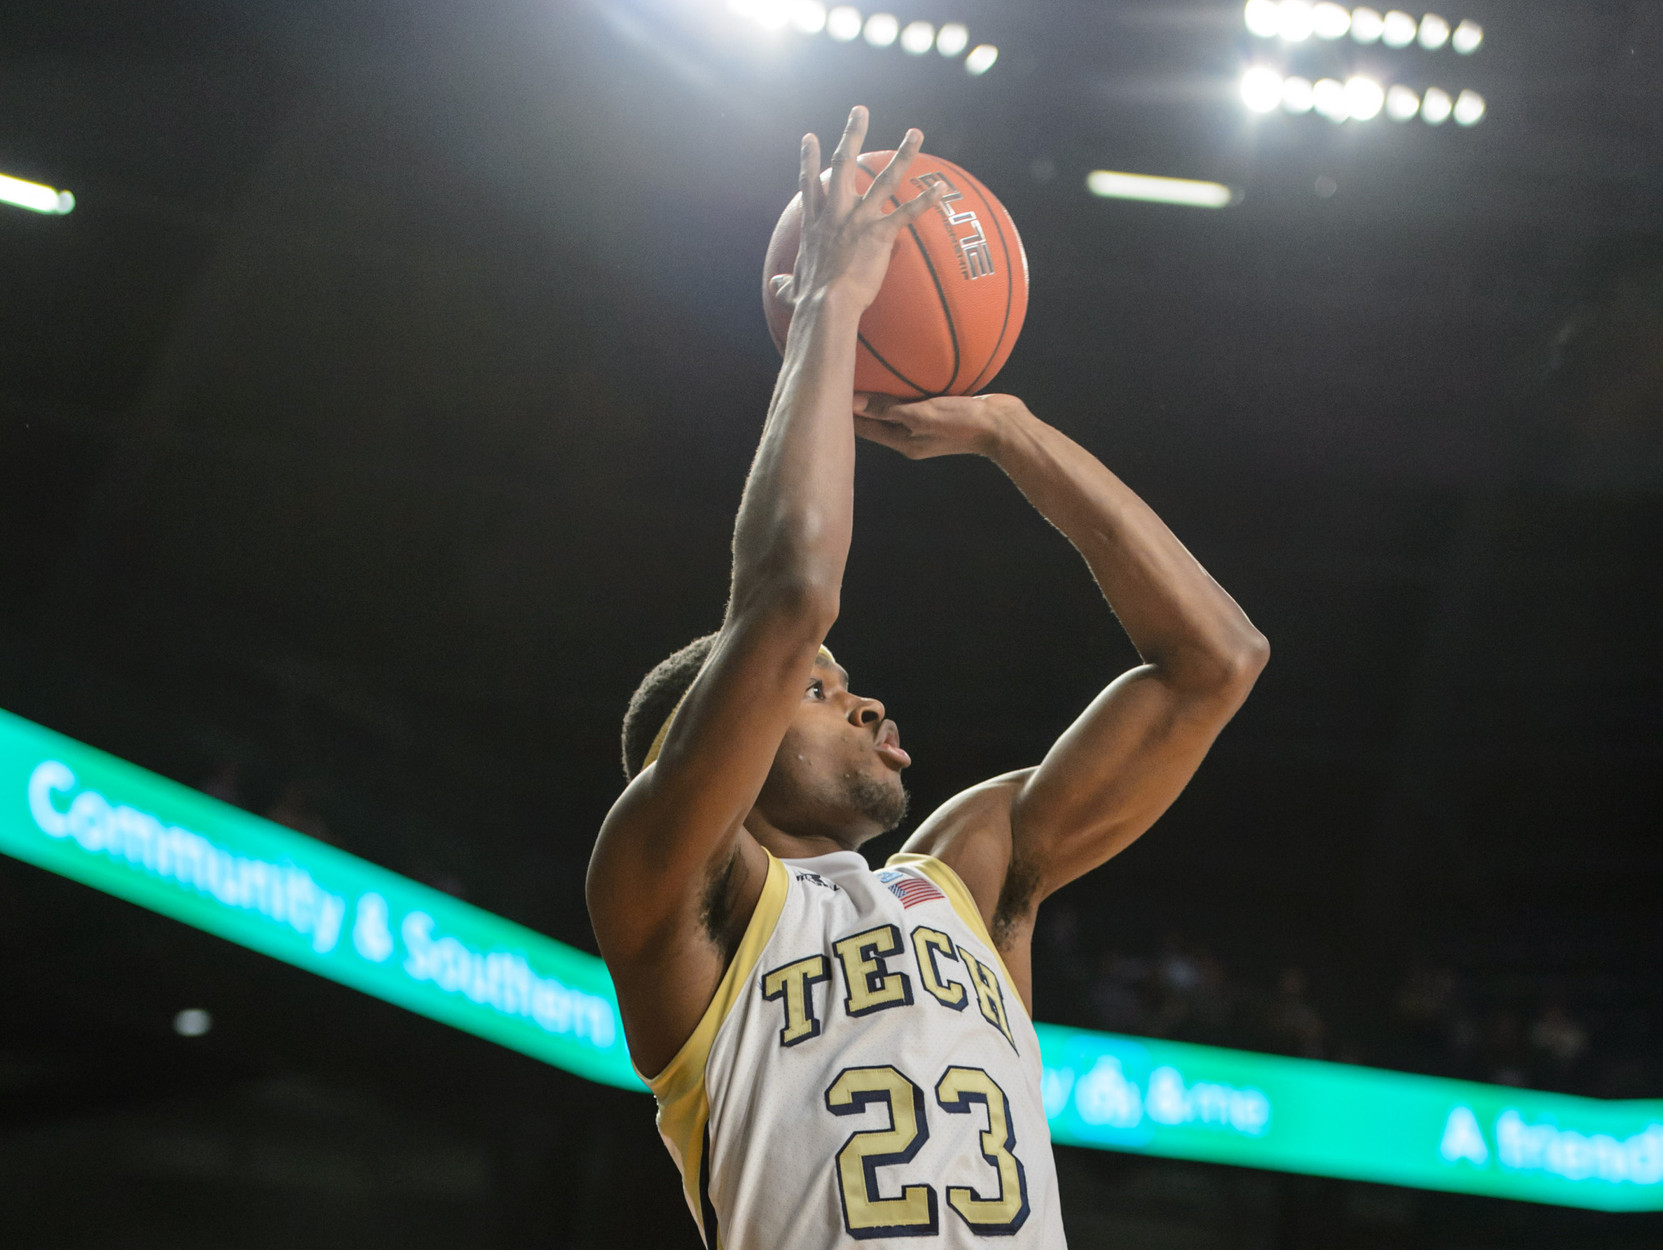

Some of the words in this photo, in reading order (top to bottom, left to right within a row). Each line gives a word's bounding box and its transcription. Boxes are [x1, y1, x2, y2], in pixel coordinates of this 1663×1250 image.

[917, 171, 996, 280] ELITE
[28, 760, 345, 953] Community
[401, 910, 616, 1049] Southern
[762, 923, 1020, 1058] TECH
[825, 1065, 1031, 1240] 23
